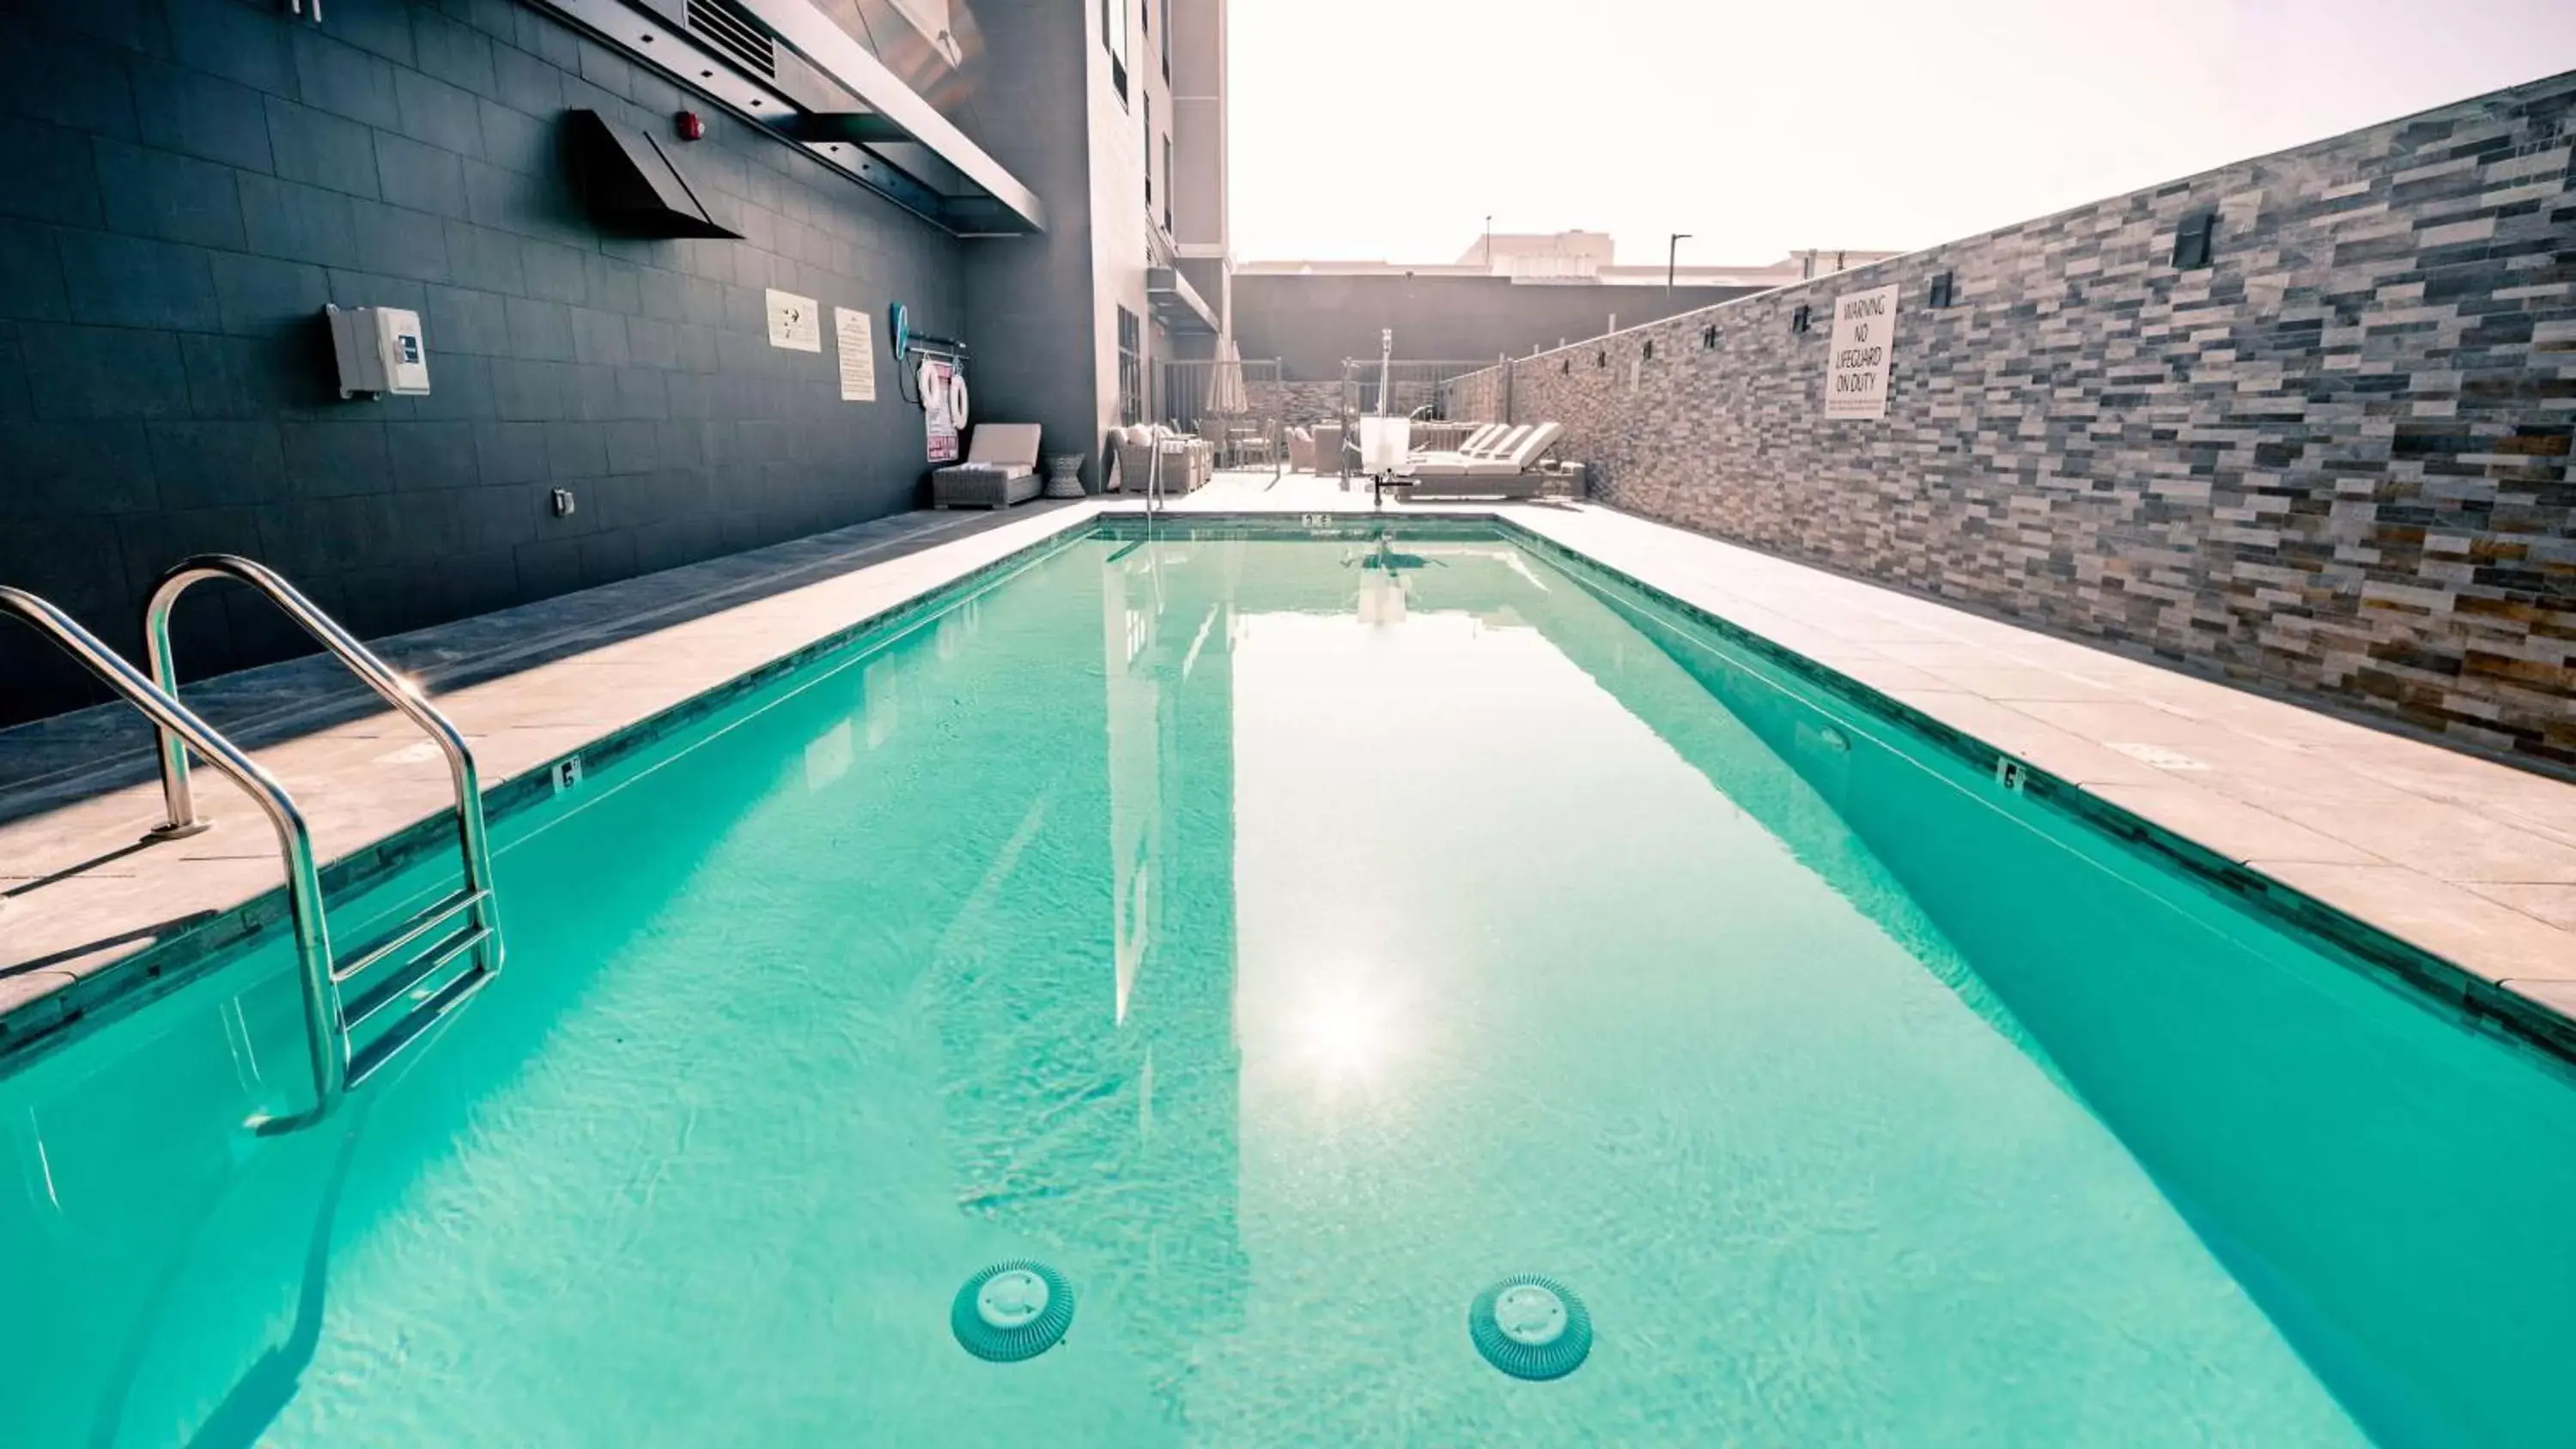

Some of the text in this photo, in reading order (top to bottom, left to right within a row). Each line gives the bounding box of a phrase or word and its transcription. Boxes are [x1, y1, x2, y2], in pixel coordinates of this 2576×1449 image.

[1844, 294, 1886, 321] WARNING
[1855, 323, 1868, 343] NO
[1836, 346, 1882, 369] LIFEGUARD
[1837, 372, 1876, 394] ON DUTY
